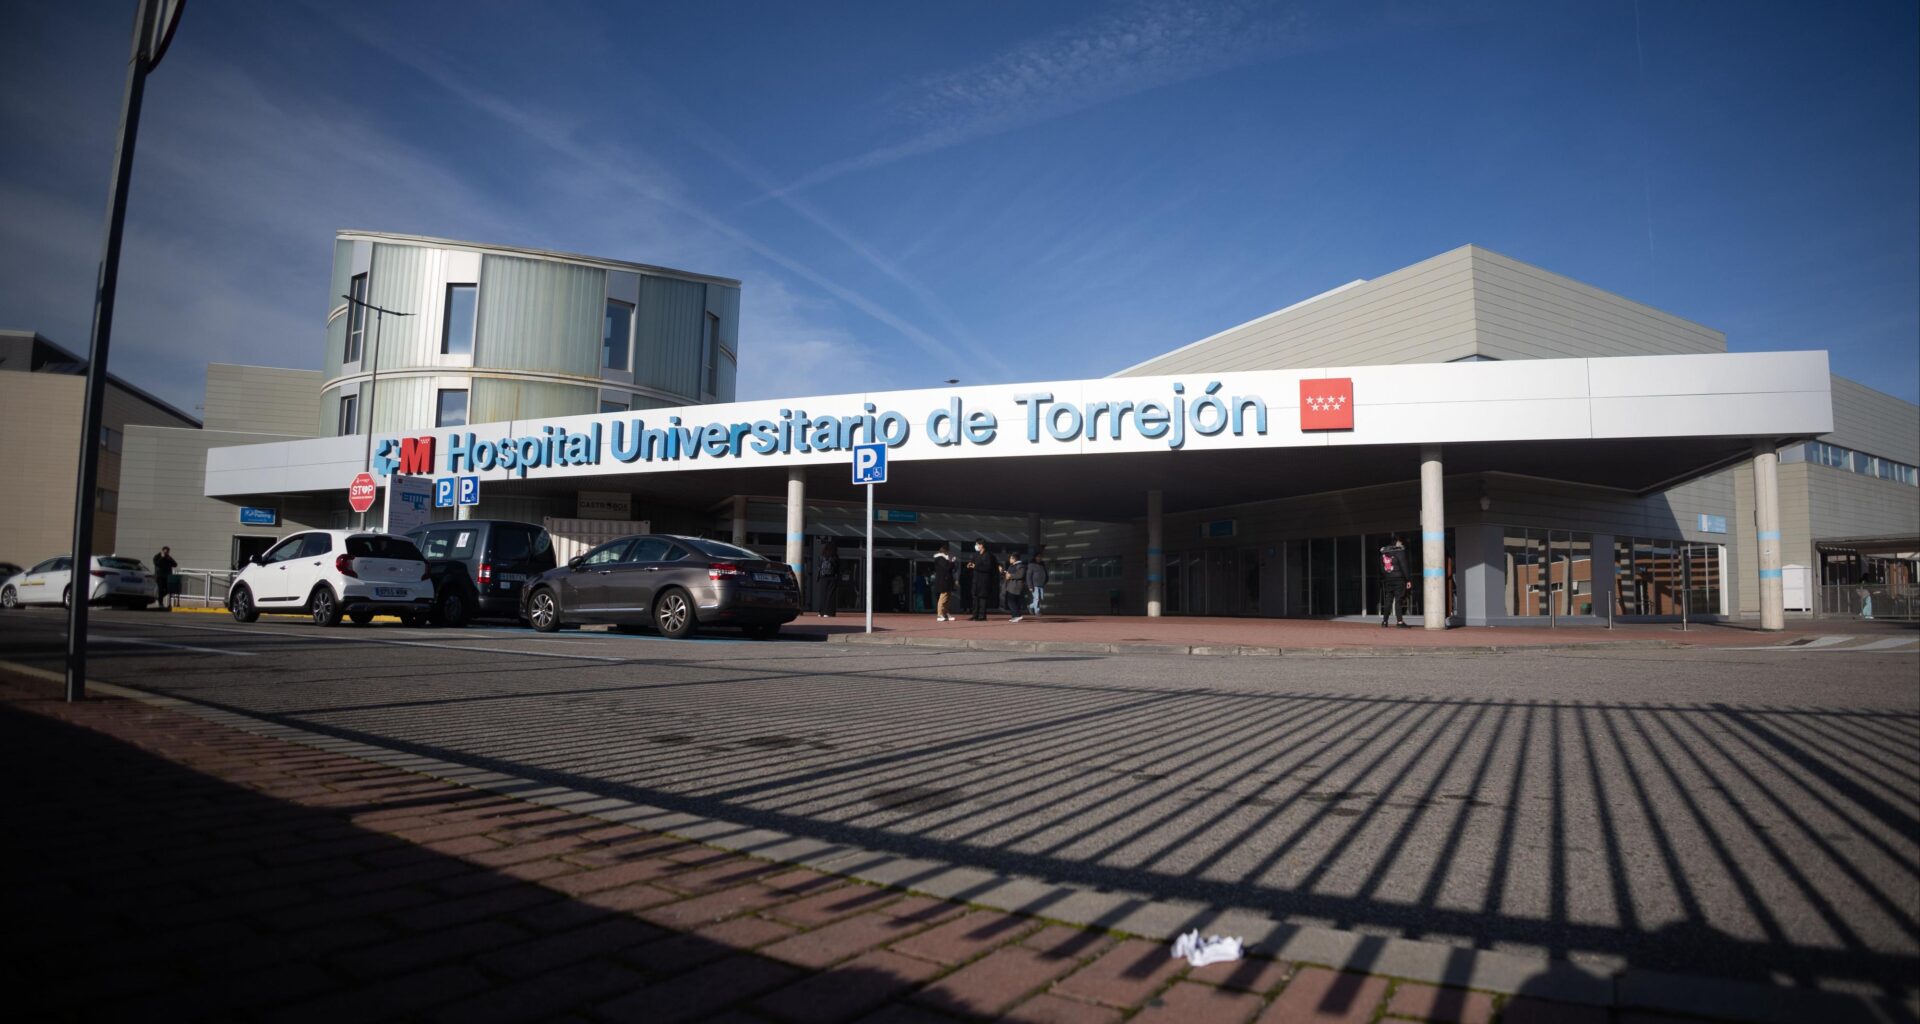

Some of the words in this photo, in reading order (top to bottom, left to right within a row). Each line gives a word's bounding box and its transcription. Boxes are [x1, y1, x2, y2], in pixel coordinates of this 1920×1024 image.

[447, 422, 602, 478] Hospital
[610, 402, 910, 463] Universitario
[926, 396, 997, 446] de
[1013, 381, 1268, 449] Torrejón
[856, 448, 877, 479] P
[352, 484, 374, 496] STOP
[439, 480, 451, 504] P
[460, 479, 474, 502] P
